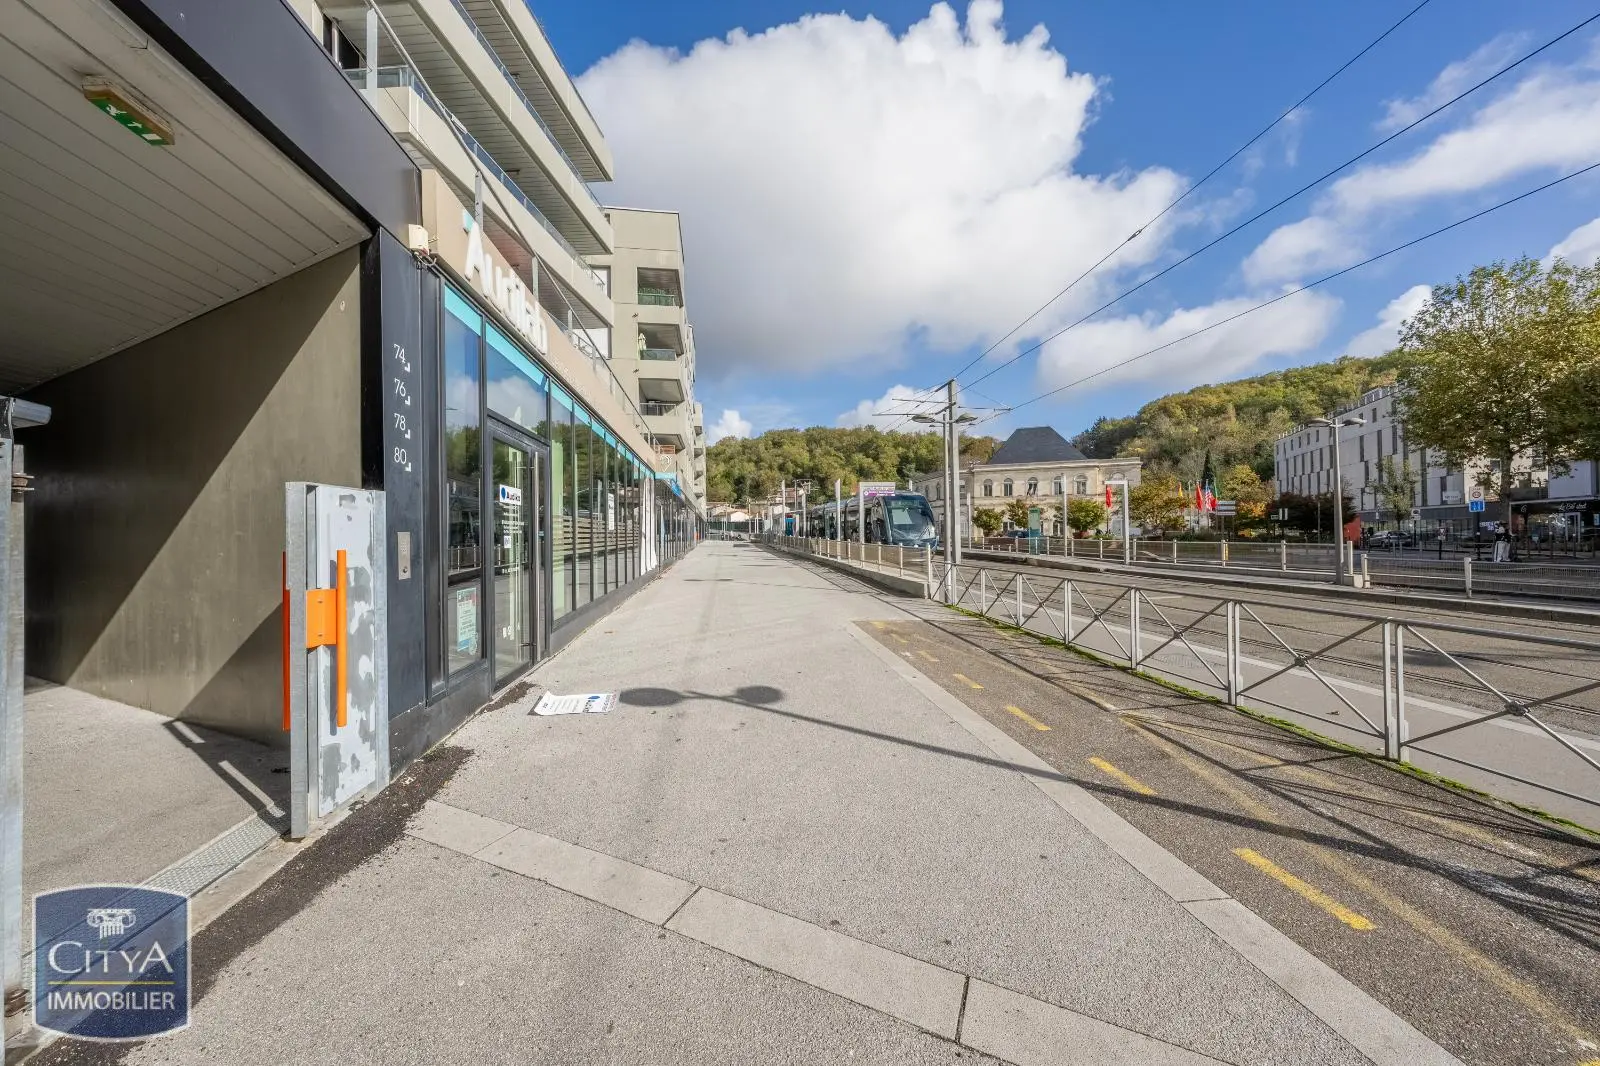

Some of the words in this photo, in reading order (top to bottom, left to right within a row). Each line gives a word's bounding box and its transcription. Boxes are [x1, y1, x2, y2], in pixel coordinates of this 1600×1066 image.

[393, 343, 406, 364] 74
[394, 377, 407, 398] 76
[393, 412, 406, 431] 78
[394, 446, 407, 465] 80
